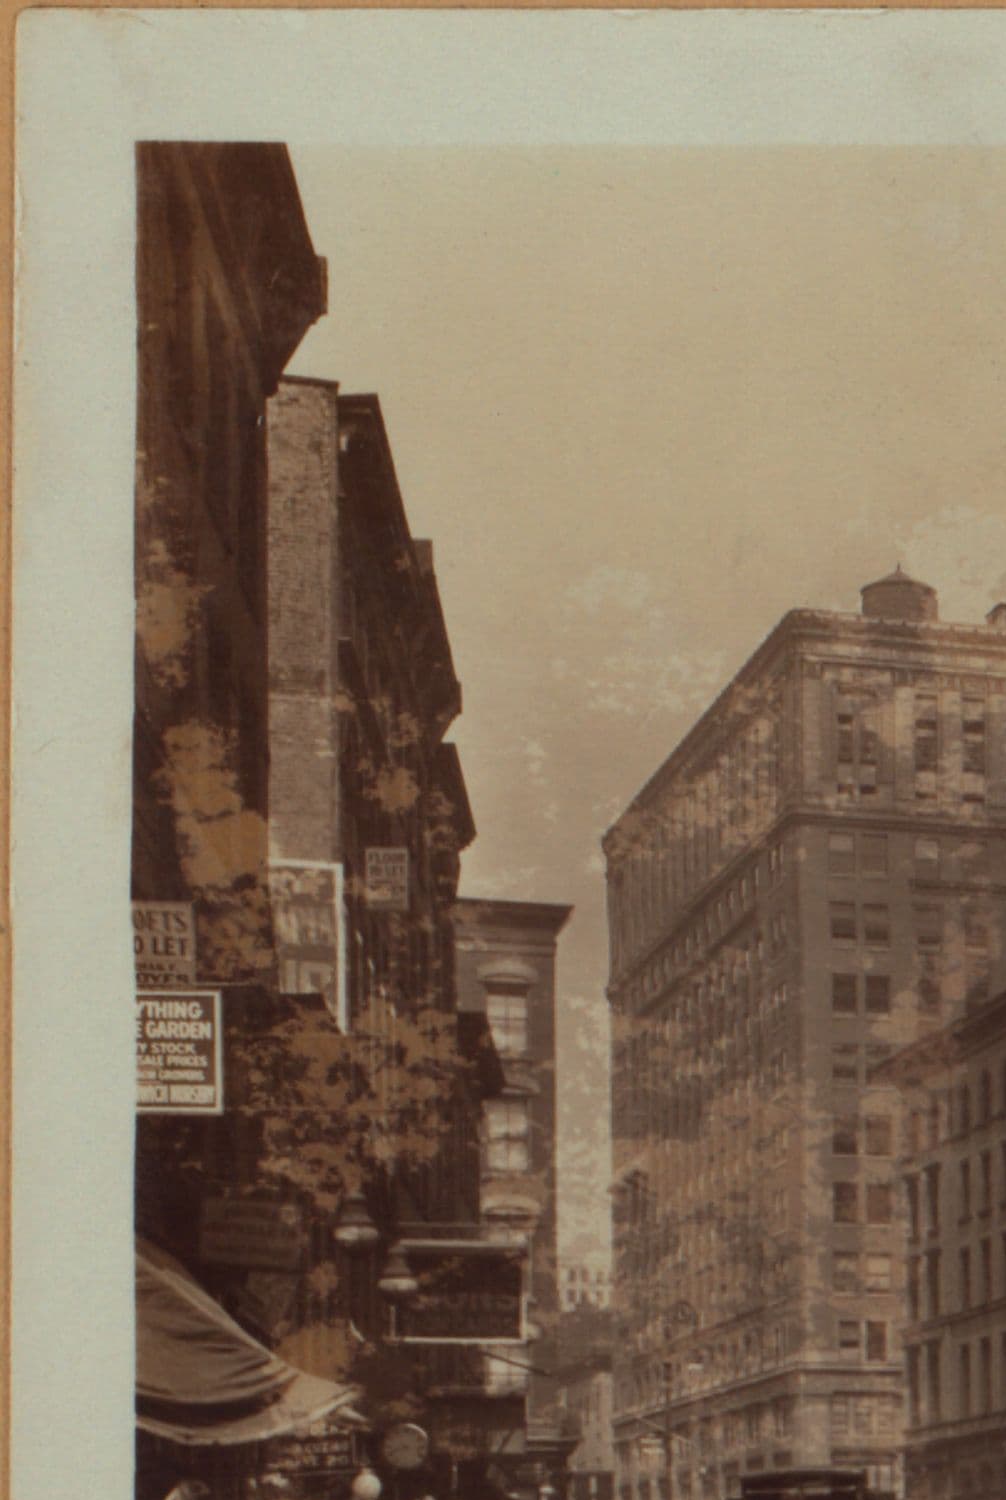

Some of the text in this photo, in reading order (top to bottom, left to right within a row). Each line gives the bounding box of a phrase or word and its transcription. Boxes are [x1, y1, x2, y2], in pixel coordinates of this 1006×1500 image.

[152, 936, 187, 956] LET
[145, 1020, 212, 1039] GARDEN
[151, 1042, 197, 1055] STOCK
[166, 1055, 209, 1067] PRICES
